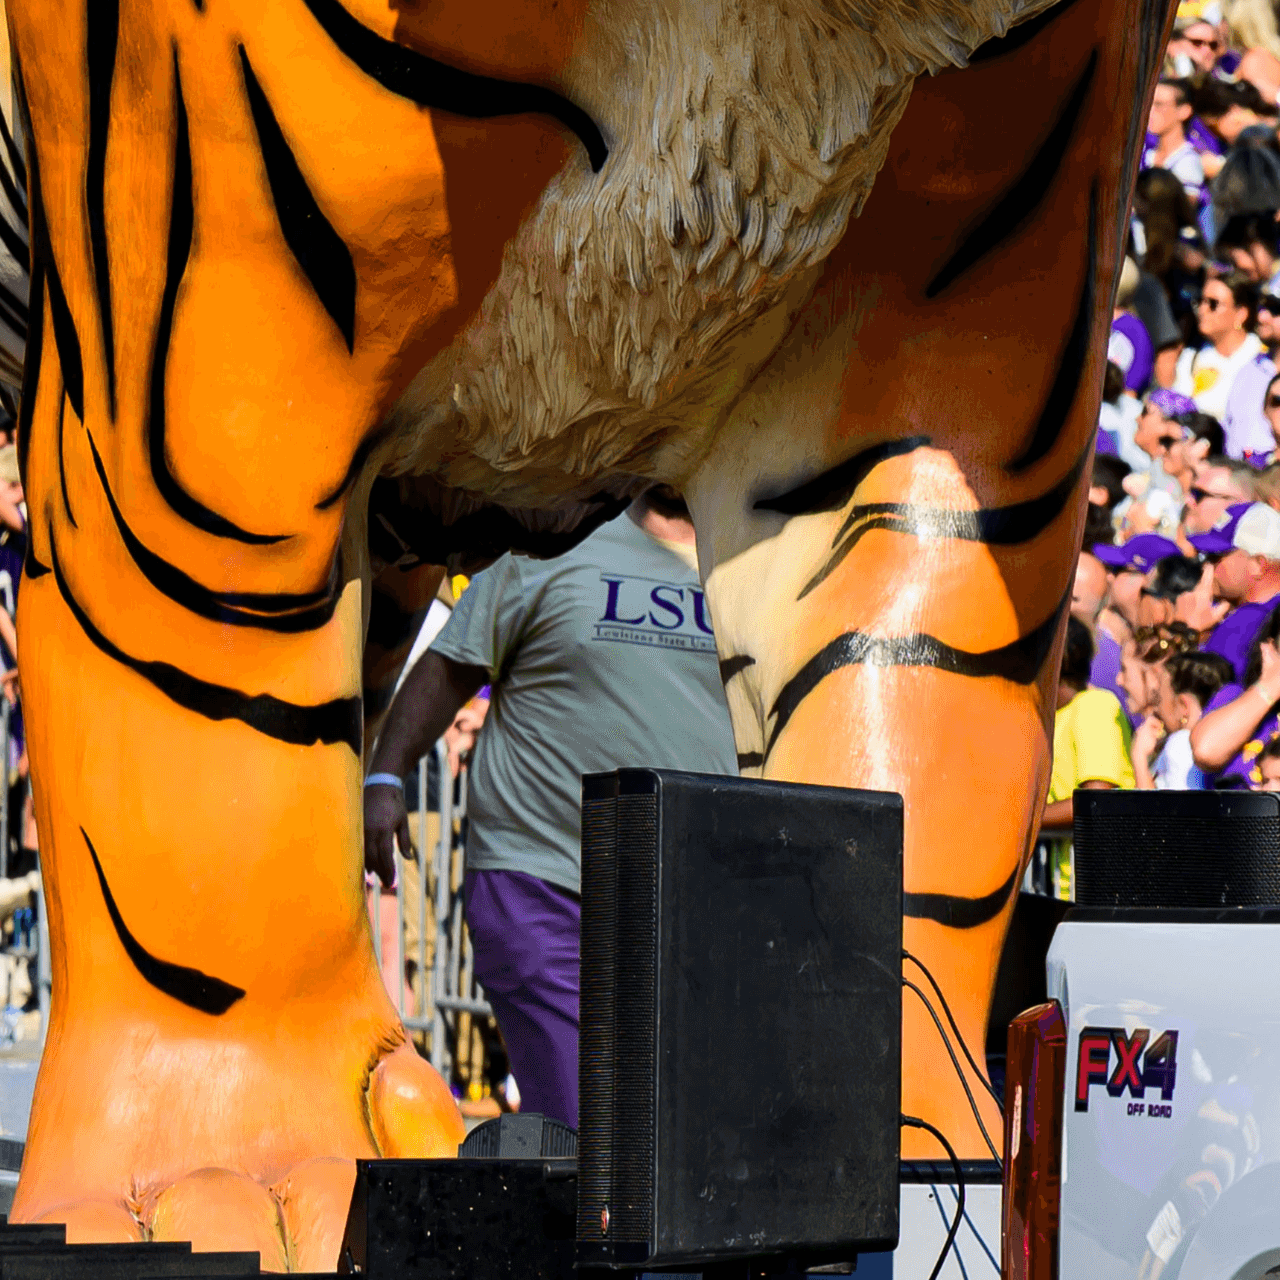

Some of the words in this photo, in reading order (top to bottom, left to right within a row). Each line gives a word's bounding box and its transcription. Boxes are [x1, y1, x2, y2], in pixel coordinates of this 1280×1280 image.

[1074, 1026, 1179, 1113] FX4
[1127, 1102, 1145, 1117] OFF
[1148, 1104, 1172, 1119] ROAD
